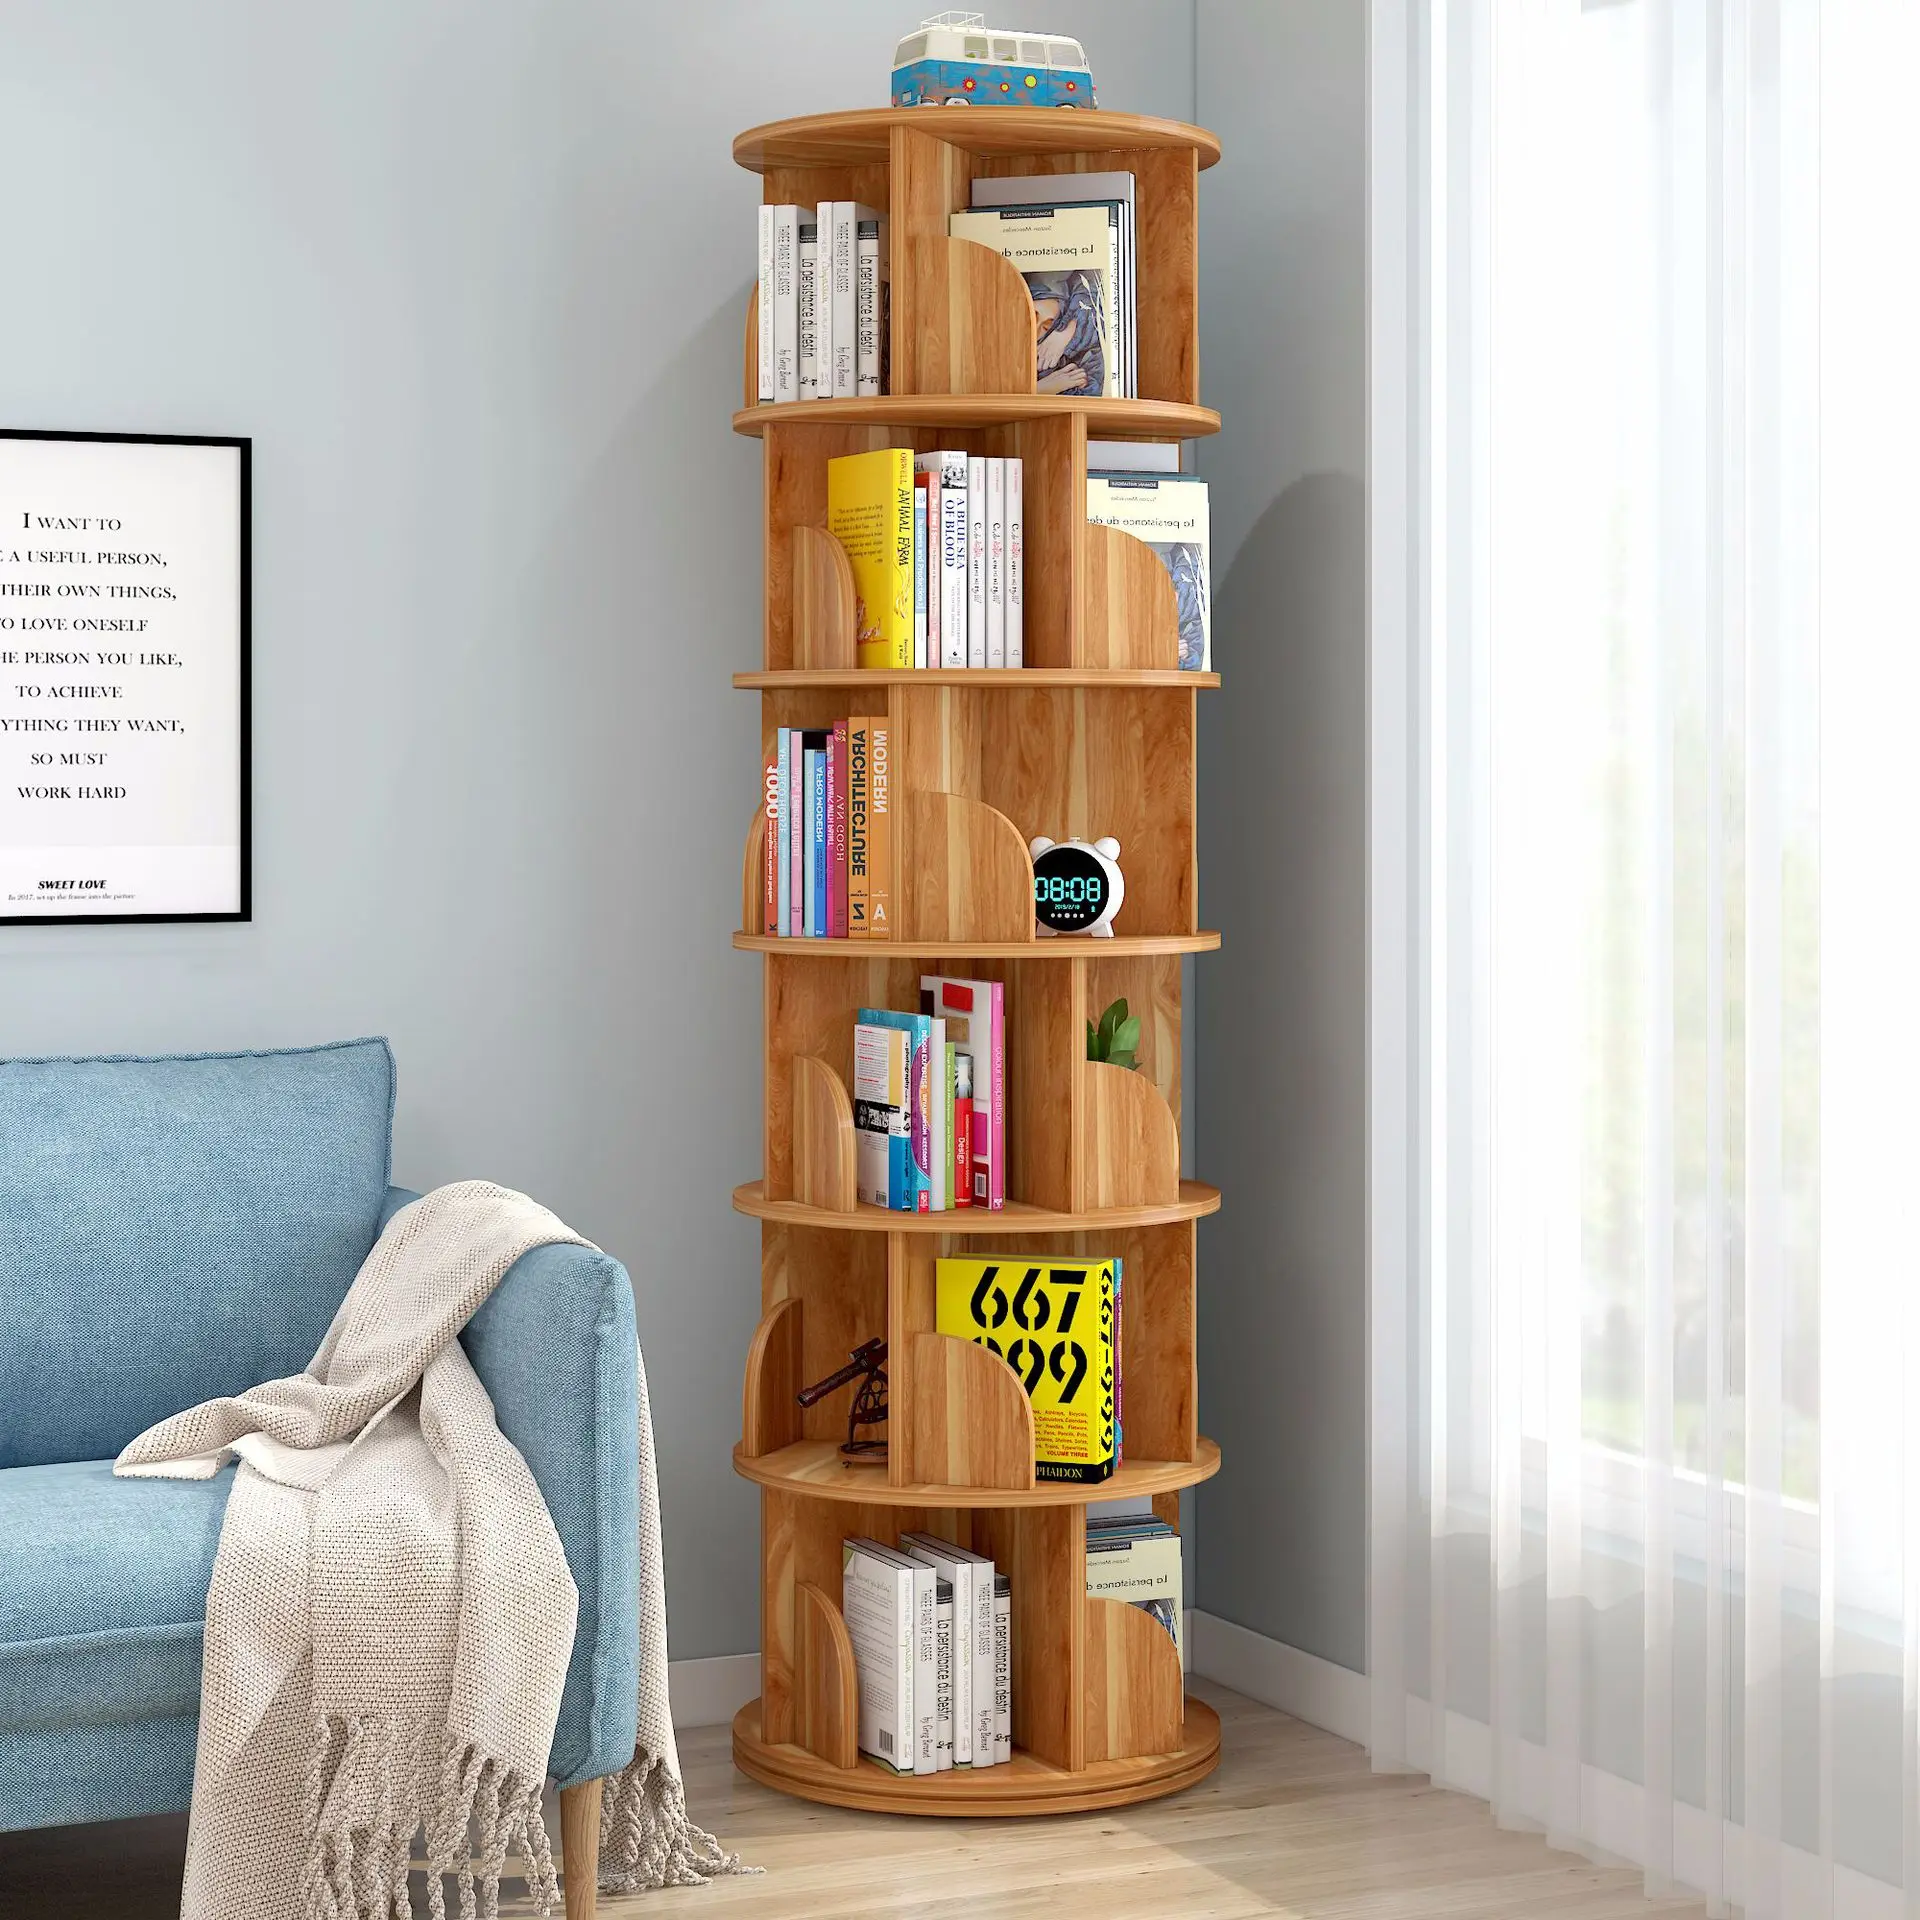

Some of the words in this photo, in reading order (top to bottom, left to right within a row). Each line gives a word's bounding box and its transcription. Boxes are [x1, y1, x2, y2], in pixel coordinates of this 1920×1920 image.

[778, 225, 790, 242] THREE
[837, 222, 849, 239] THREE
[778, 244, 790, 260] PAIRS
[837, 241, 849, 257] PAIRS
[861, 254, 878, 263] La
[778, 271, 790, 296] GLASSES
[837, 267, 849, 292] GLASSES
[860, 267, 877, 315] persistance
[861, 317, 878, 328] du
[861, 330, 878, 355] destin
[899, 452, 907, 485] ORWELL
[897, 488, 911, 533] ANIMAL
[945, 499, 955, 518] OF
[956, 497, 965, 506] A
[23, 512, 30, 529] I
[38, 517, 91, 530] WANT
[96, 518, 122, 531] TO
[956, 511, 965, 544] BLUE
[897, 536, 911, 566] FARM
[945, 520, 955, 567] BLOOD
[9, 551, 20, 563] A
[27, 551, 92, 564] USEFUL
[98, 552, 167, 568] PERSON,
[956, 547, 965, 570] SEA
[0, 584, 51, 597] THEIR
[57, 585, 100, 598] OWN
[106, 585, 177, 602] THINGS,
[21, 618, 68, 631] LOVE
[73, 618, 149, 632] ONESELF
[25, 652, 90, 665] PERSON
[97, 652, 133, 666] YOU
[140, 653, 183, 668] LIKE,
[15, 685, 41, 698] TO
[47, 685, 123, 699] ACHIEVE
[73, 719, 121, 732] THEY
[127, 719, 185, 734] WANT,
[30, 752, 53, 766] SO
[60, 753, 107, 766] MUST
[18, 786, 71, 800] WORK
[78, 786, 127, 799] HARD
[38, 880, 76, 890] SWEET
[78, 880, 107, 890] LOVE
[1035, 877, 1101, 902] 08:08
[994, 1077, 1003, 1124] inspiration
[957, 1137, 966, 1164] Design
[970, 1266, 1088, 1333] 667
[1101, 1267, 1113, 1453] 667-999
[1036, 1466, 1083, 1479] PHAIDON
[920, 1589, 932, 1608] THREE
[979, 1583, 990, 1602] THREE
[920, 1610, 932, 1625] PAIRS
[979, 1603, 990, 1619] PAIRS
[995, 1613, 1010, 1623] La
[937, 1619, 952, 1629] La
[920, 1636, 932, 1662] GLASSES
[979, 1630, 990, 1655] GLASSES
[995, 1626, 1010, 1672] persistance
[937, 1682, 952, 1694] du
[995, 1675, 1010, 1686] du
[937, 1697, 952, 1721] destin
[995, 1689, 1010, 1714] destin
[920, 1716, 933, 1724] by
[979, 1718, 991, 1731] Greg
